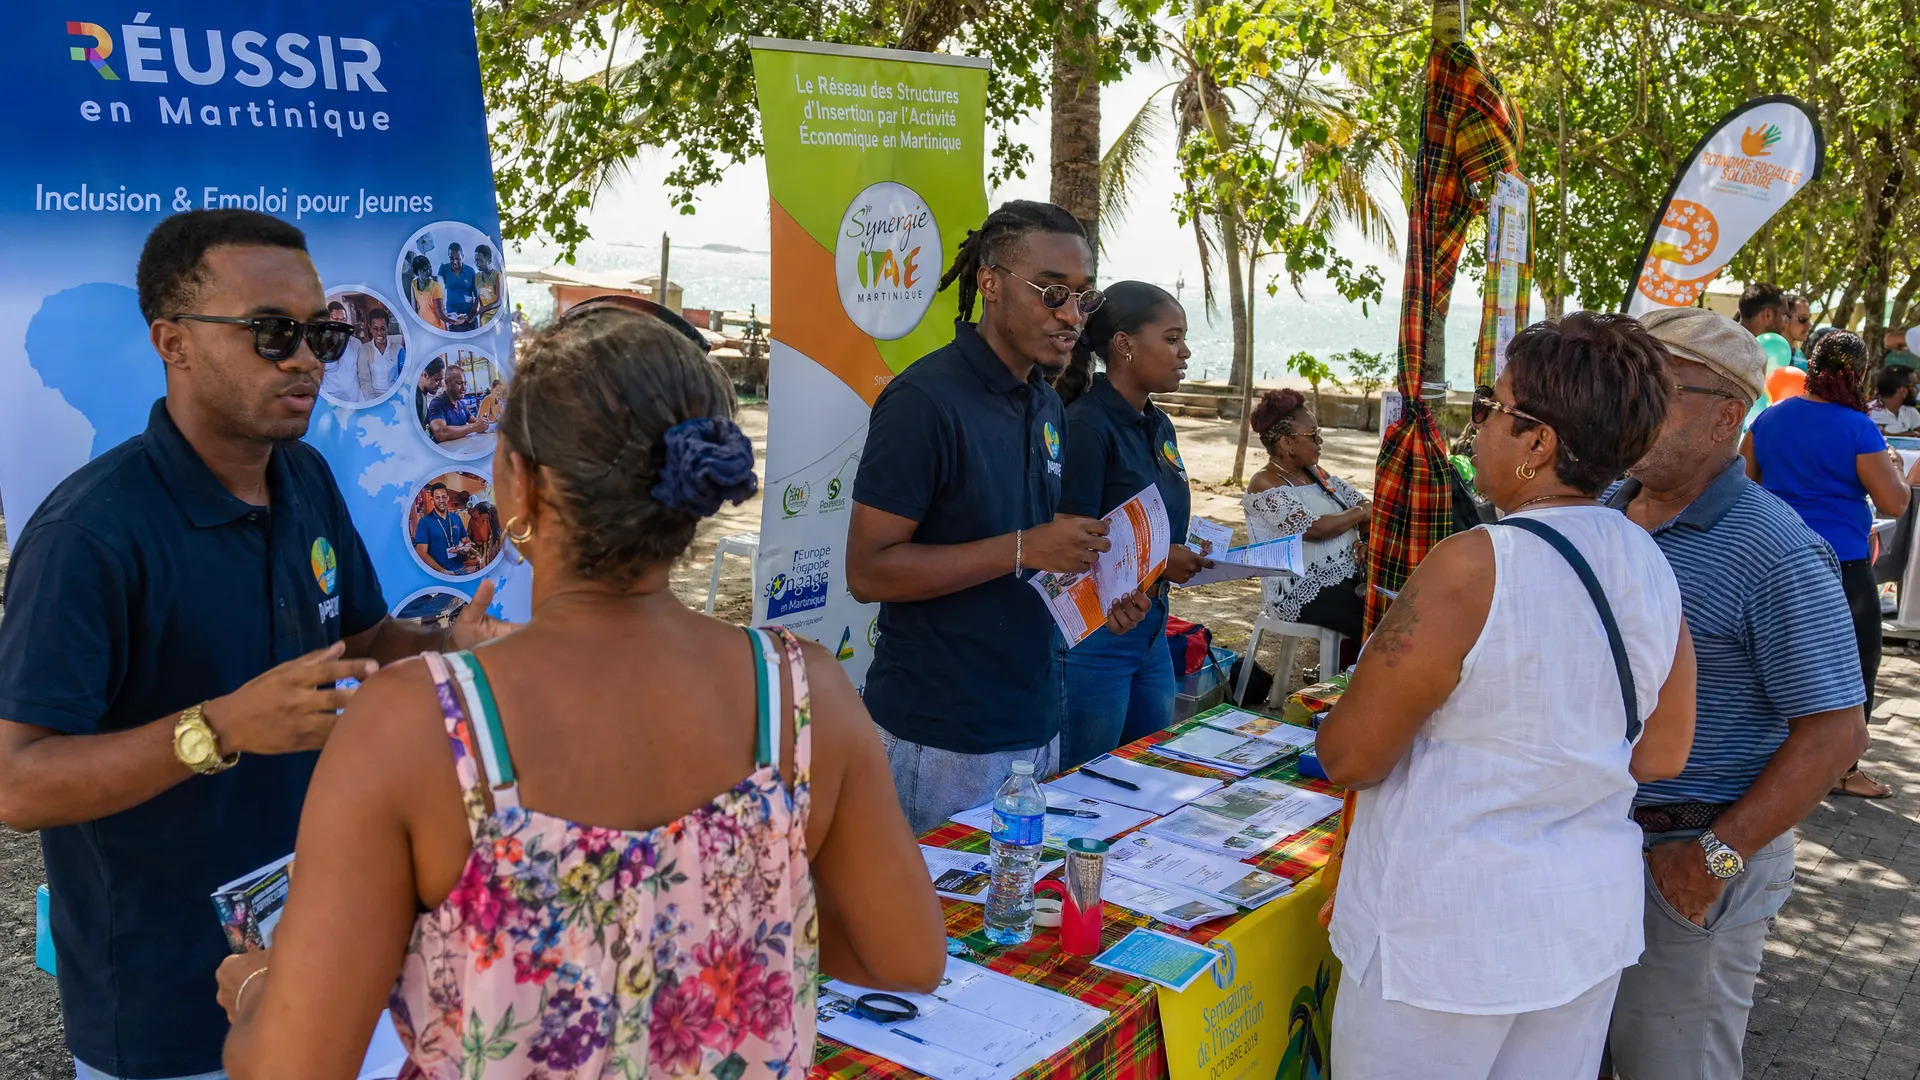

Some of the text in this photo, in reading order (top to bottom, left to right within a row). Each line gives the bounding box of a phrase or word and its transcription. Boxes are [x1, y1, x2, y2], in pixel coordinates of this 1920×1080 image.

[66, 11, 388, 93] RÉUSSIR
[795, 73, 960, 105] Le Réseau des Structures
[80, 96, 391, 138] en Martinique
[803, 100, 957, 128] d'Insertion par l'Activité
[800, 120, 962, 155] Économique en Martinique
[1701, 152, 1754, 172] ECONOMIE
[1752, 160, 1793, 183] SOCIALE
[1720, 167, 1774, 190] SOLIDAIRE
[35, 183, 434, 220] Inclusion & Emploi pour Jeunes
[846, 204, 930, 257] Synergie
[857, 289, 924, 303] MARTINIQUE
[788, 594, 826, 610] Martinique
[1197, 1041, 1211, 1069] de
[1211, 1000, 1265, 1056] l'insertion
[1210, 1044, 1243, 1080] OCTOBRE
[1244, 1032, 1259, 1056] 2019
